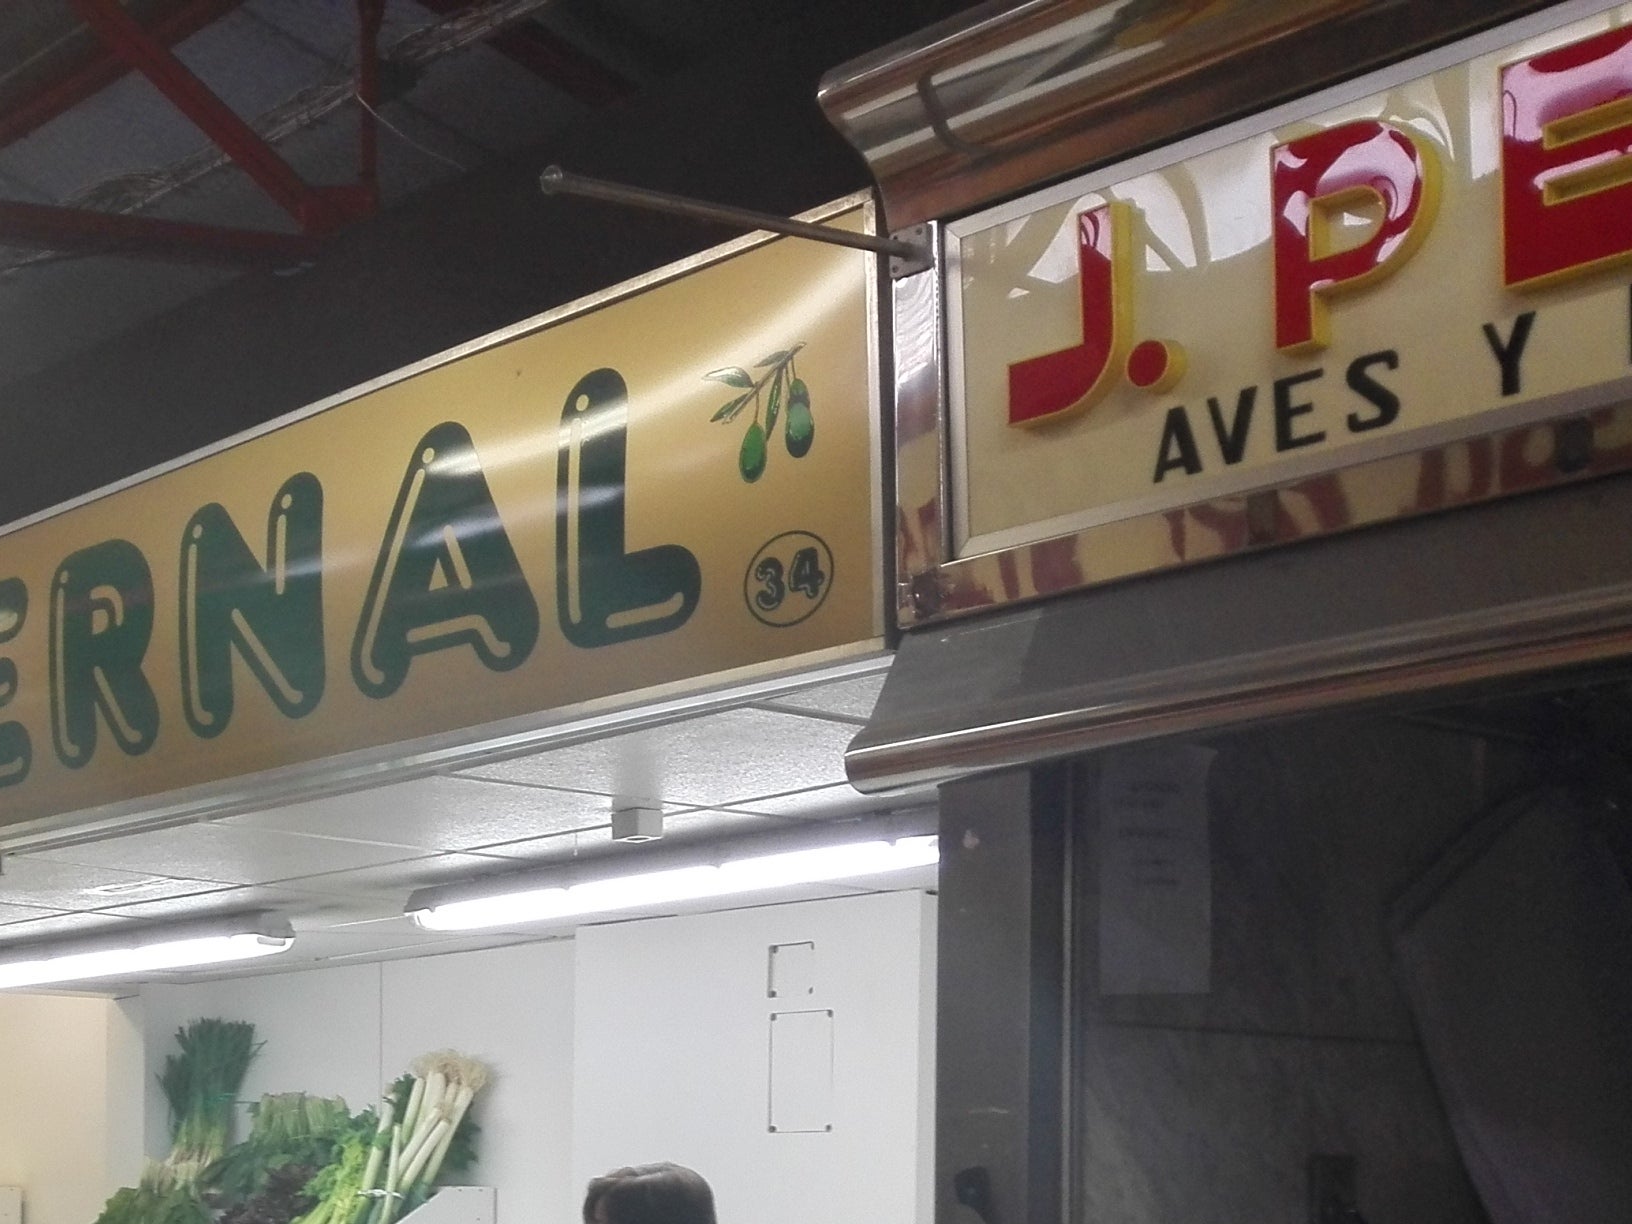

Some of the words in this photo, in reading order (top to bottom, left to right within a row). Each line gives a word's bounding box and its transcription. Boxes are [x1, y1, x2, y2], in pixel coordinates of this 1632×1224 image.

[1009, 199, 1186, 428] J.
[1153, 349, 1401, 485] AVES
[1482, 311, 1537, 397] Y
[754, 546, 826, 612] 34
